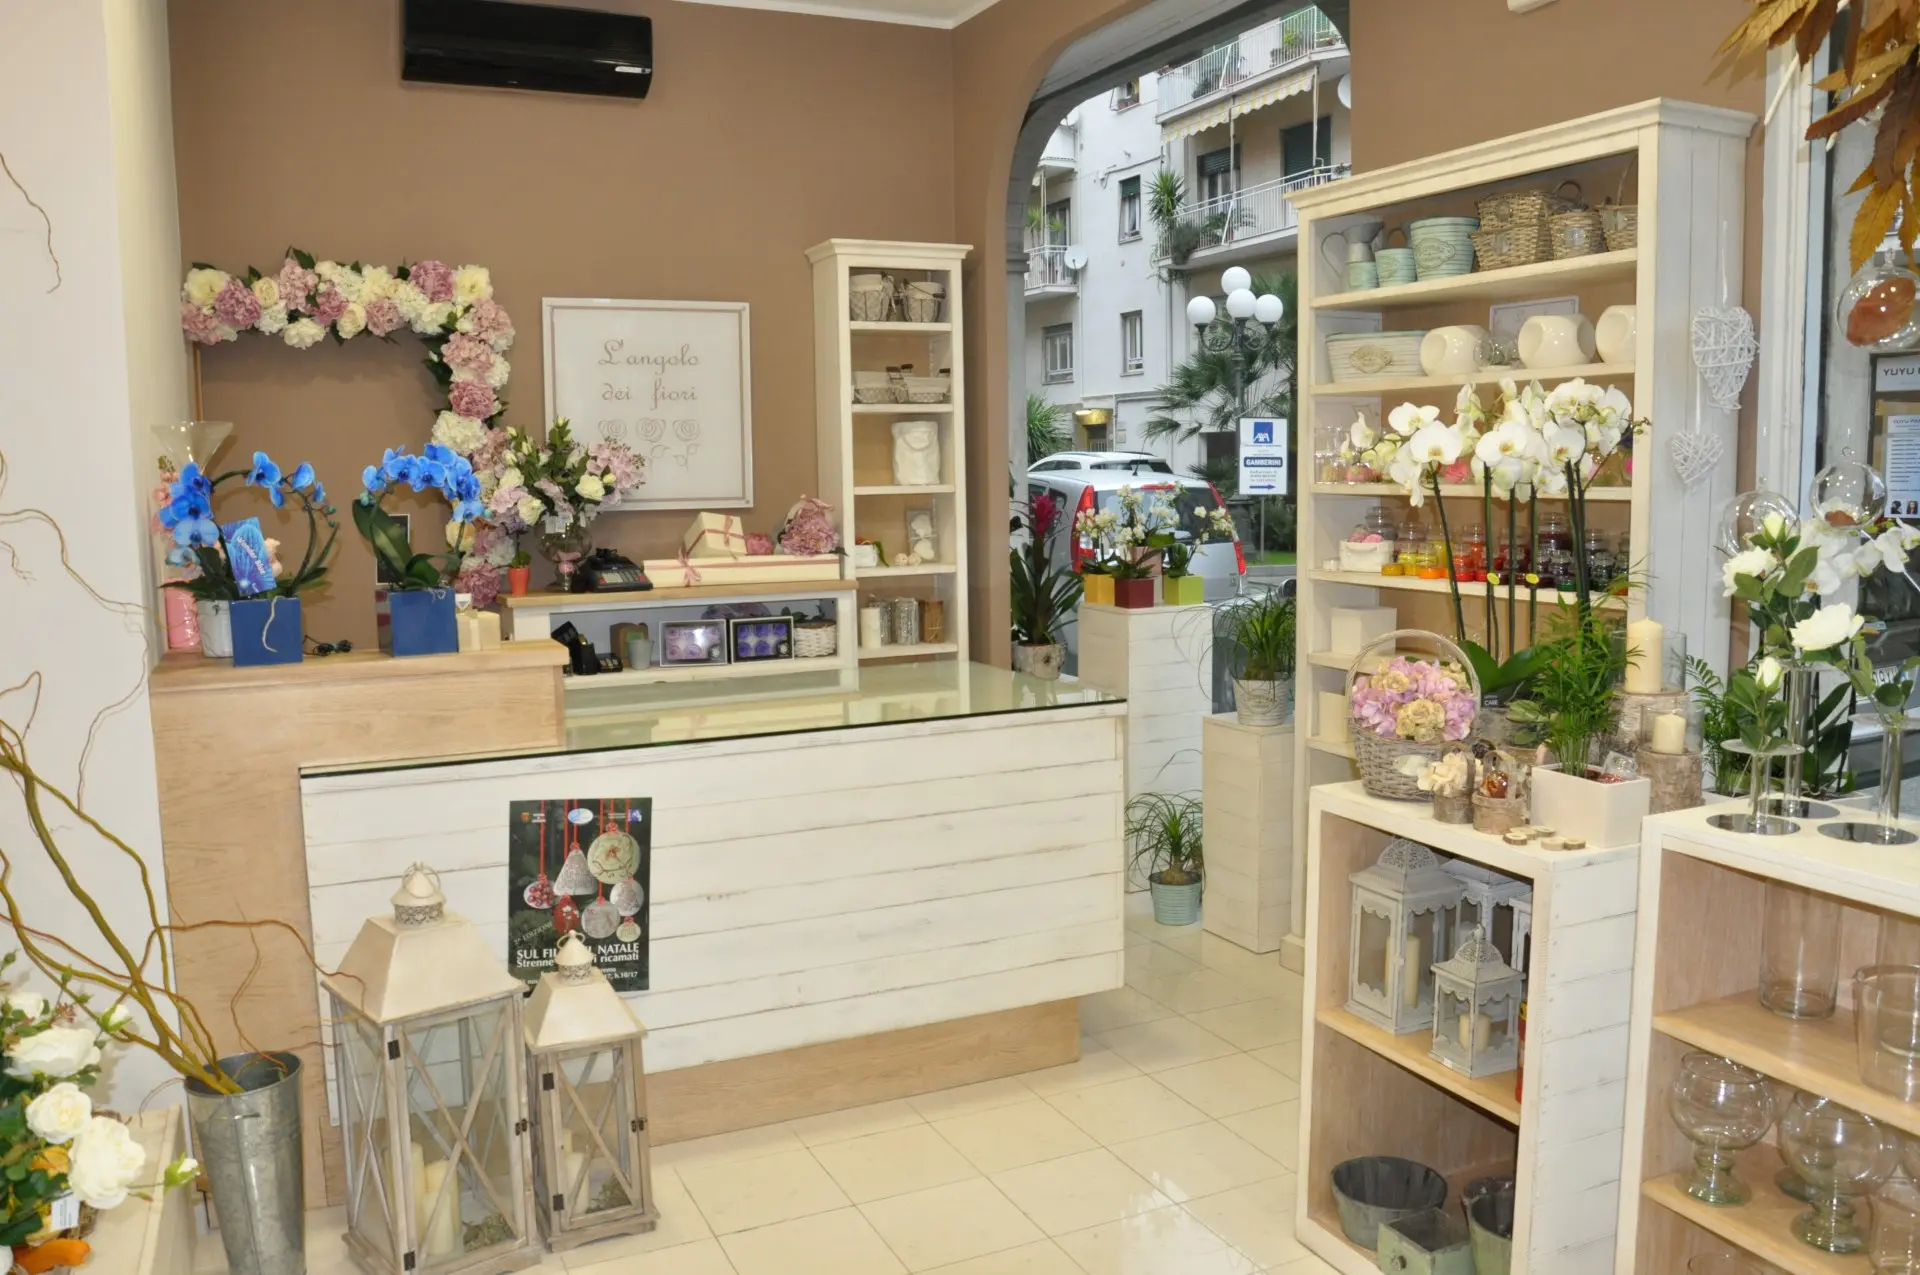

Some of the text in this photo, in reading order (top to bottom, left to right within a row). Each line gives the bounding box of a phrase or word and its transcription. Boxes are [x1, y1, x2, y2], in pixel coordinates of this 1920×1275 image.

[1883, 367, 1915, 376] YUYU
[601, 378, 698, 411] dei fiori
[1253, 433, 1270, 443] AXA
[516, 949, 540, 960] SUL
[597, 942, 640, 955] NATALE
[516, 959, 554, 968] Strenne
[600, 951, 640, 963] ricamati
